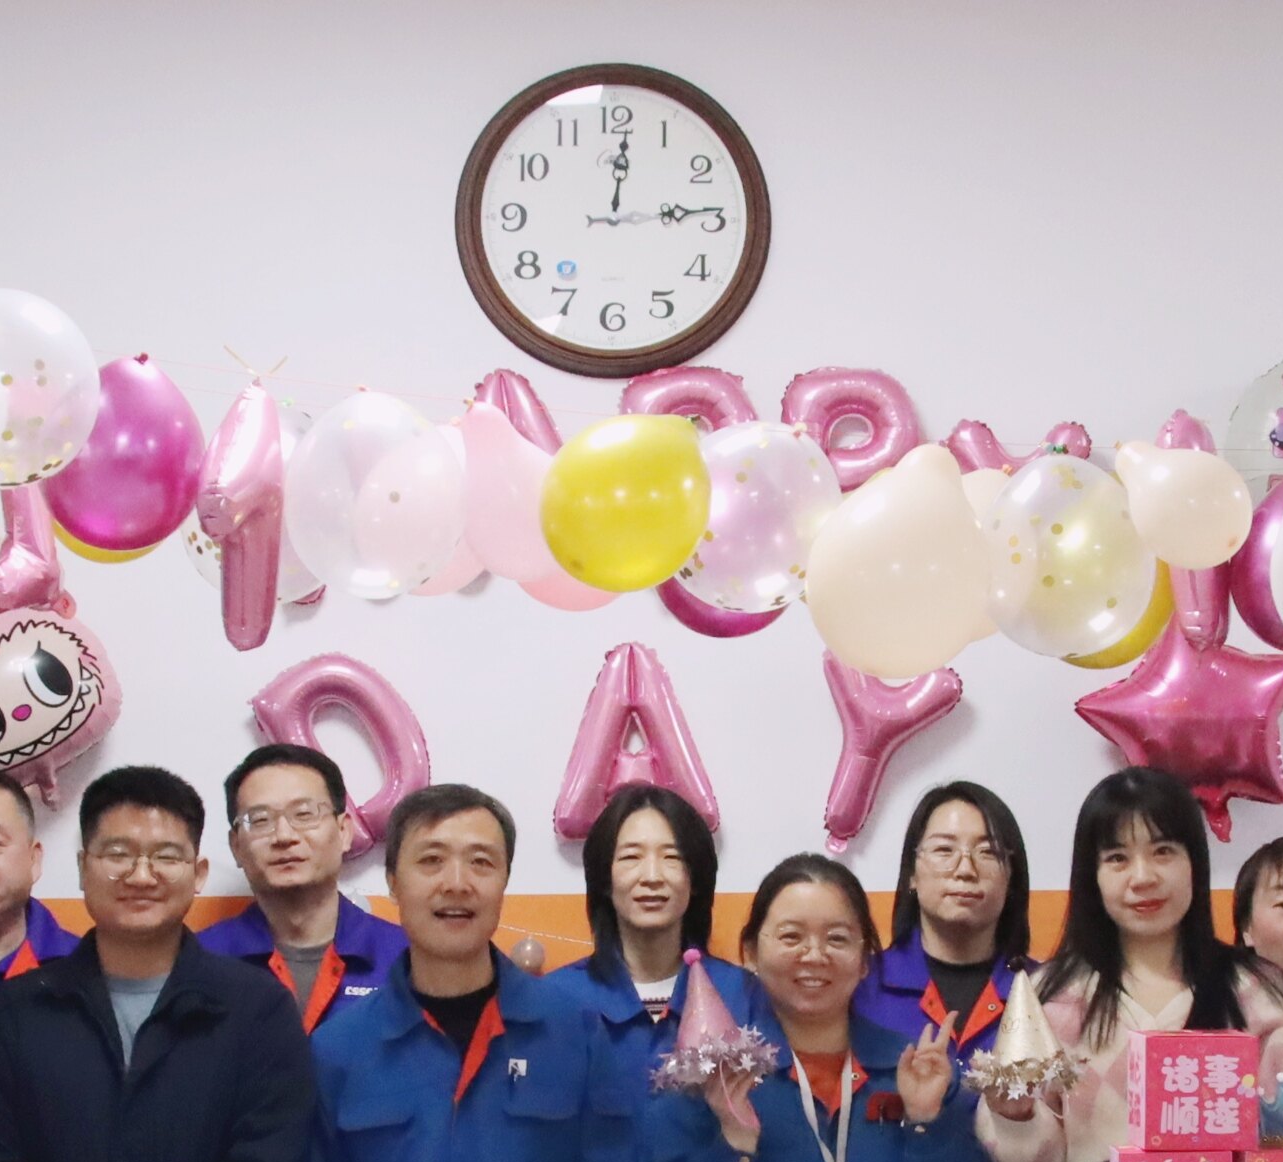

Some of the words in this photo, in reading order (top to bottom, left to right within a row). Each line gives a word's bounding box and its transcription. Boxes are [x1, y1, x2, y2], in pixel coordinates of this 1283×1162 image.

[556, 118, 578, 147] 11
[600, 105, 633, 134] 12
[660, 119, 668, 148] 1
[519, 153, 549, 181] 10
[689, 155, 713, 184] 2
[500, 202, 528, 232] 9
[701, 207, 726, 232] 3
[514, 250, 541, 280] 8
[683, 254, 711, 282] 4
[551, 286, 577, 316] 7
[649, 289, 675, 319] 5
[599, 302, 626, 332] 6
[1161, 1054, 1240, 1094] 诸事
[1160, 1096, 1240, 1135] 顺遂
